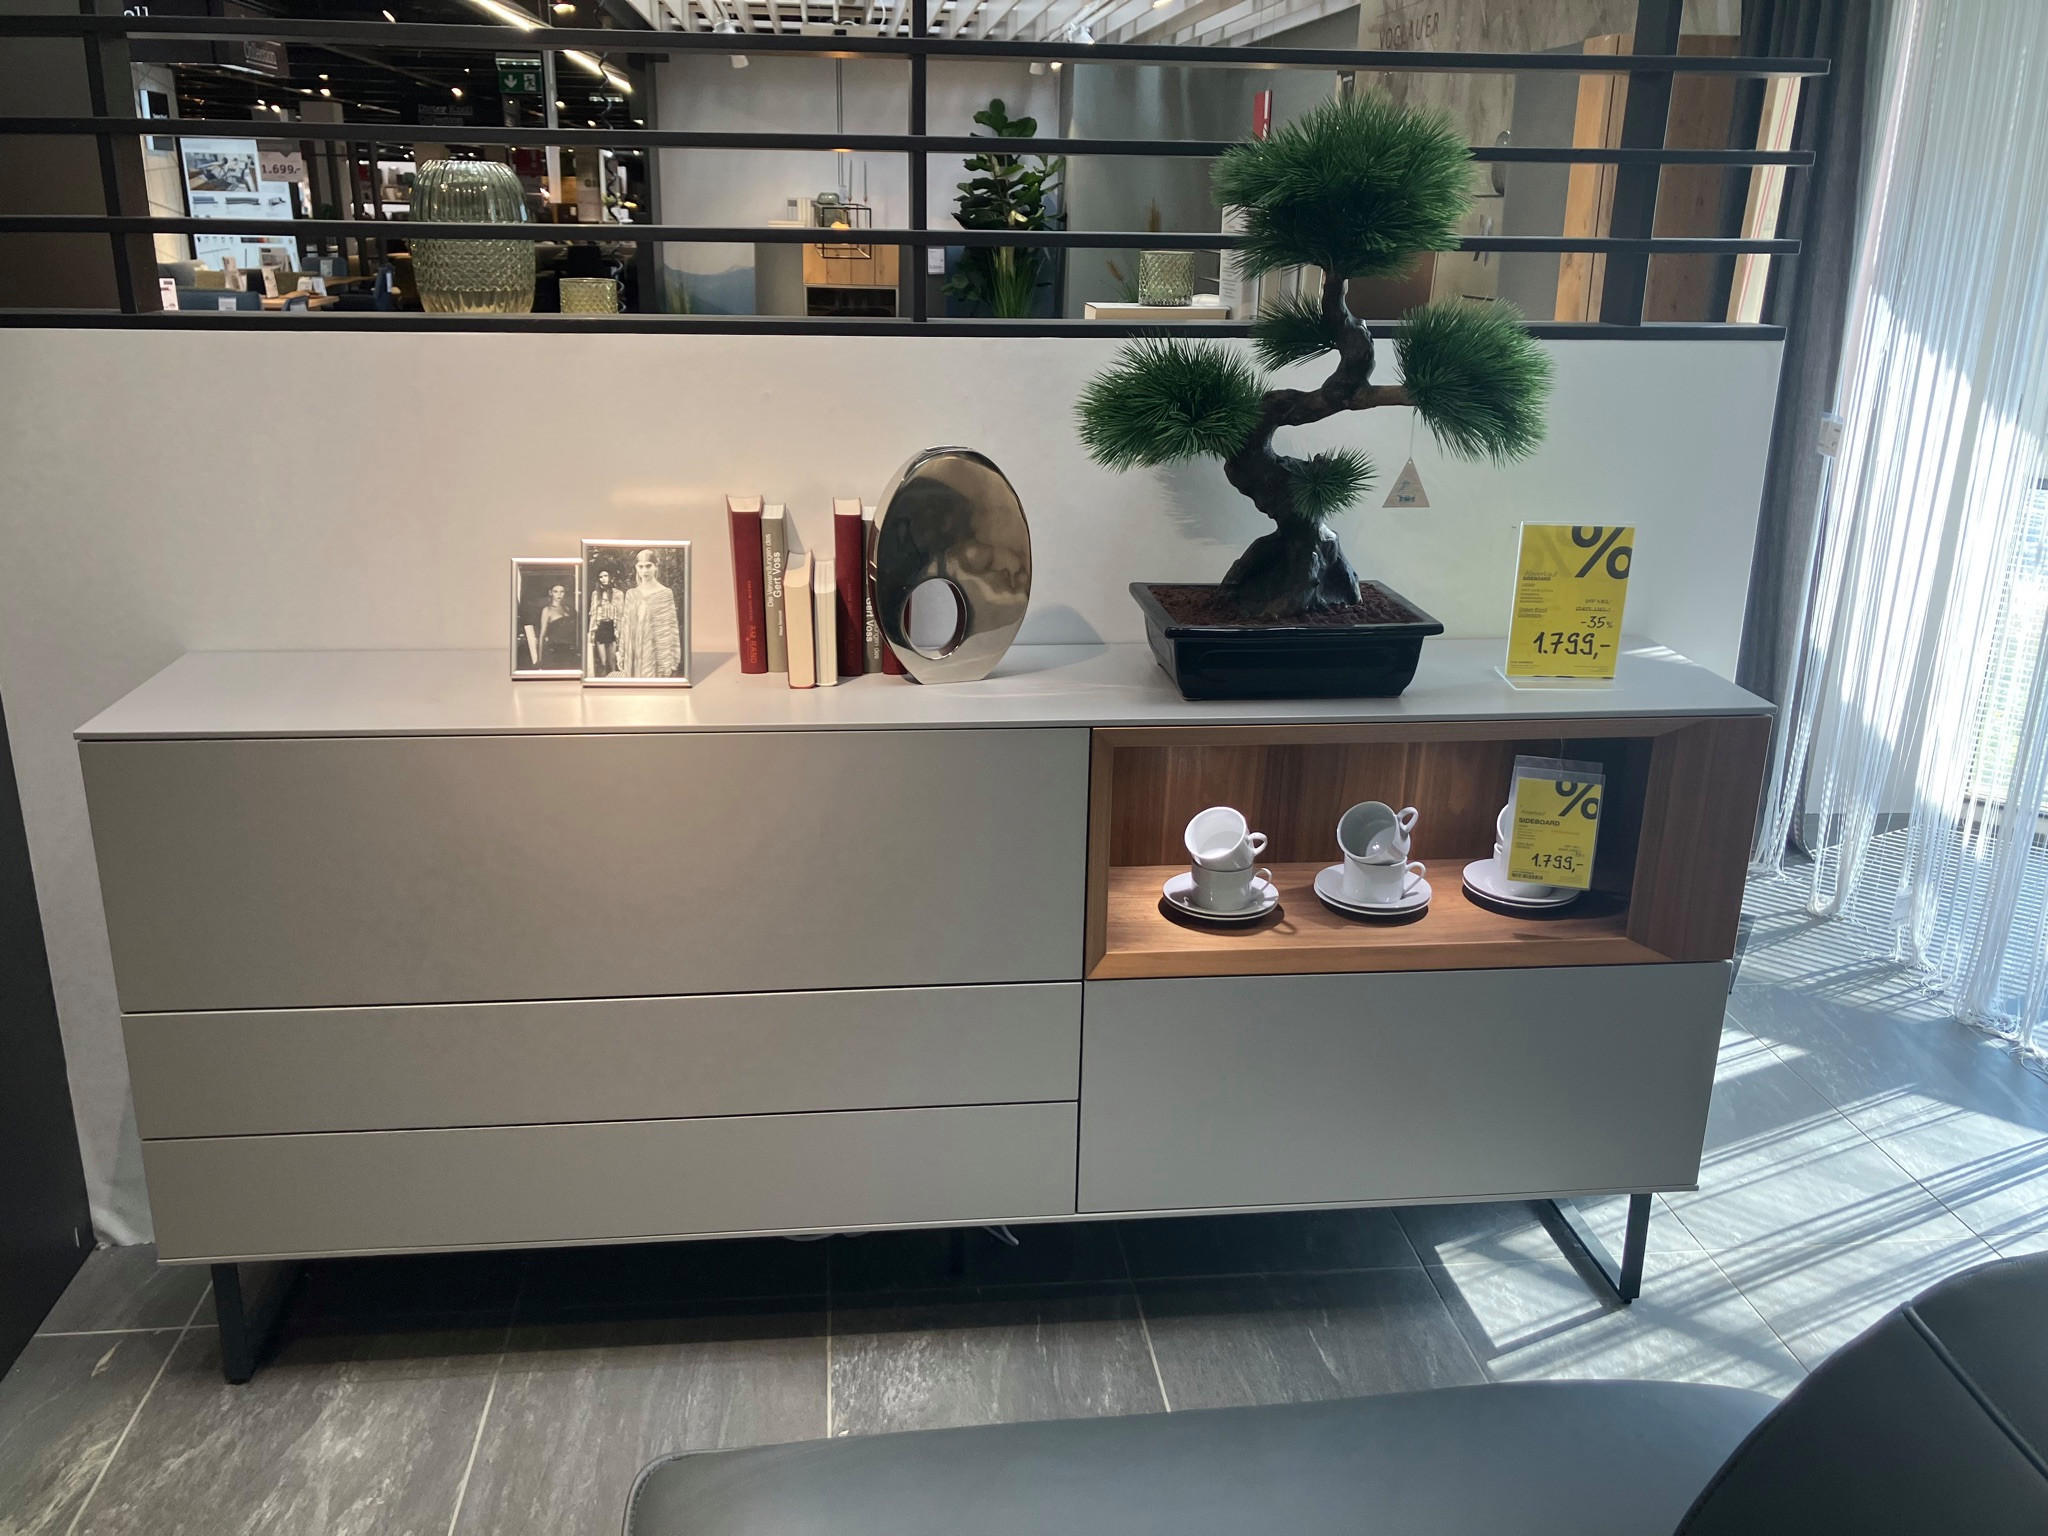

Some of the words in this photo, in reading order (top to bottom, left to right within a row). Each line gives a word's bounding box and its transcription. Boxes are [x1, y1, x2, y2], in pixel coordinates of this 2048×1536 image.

[772, 551, 781, 575] Voss
[772, 577, 782, 598] Gert
[865, 619, 875, 642] Voss
[1518, 817, 1560, 827] SIDEBOARD
